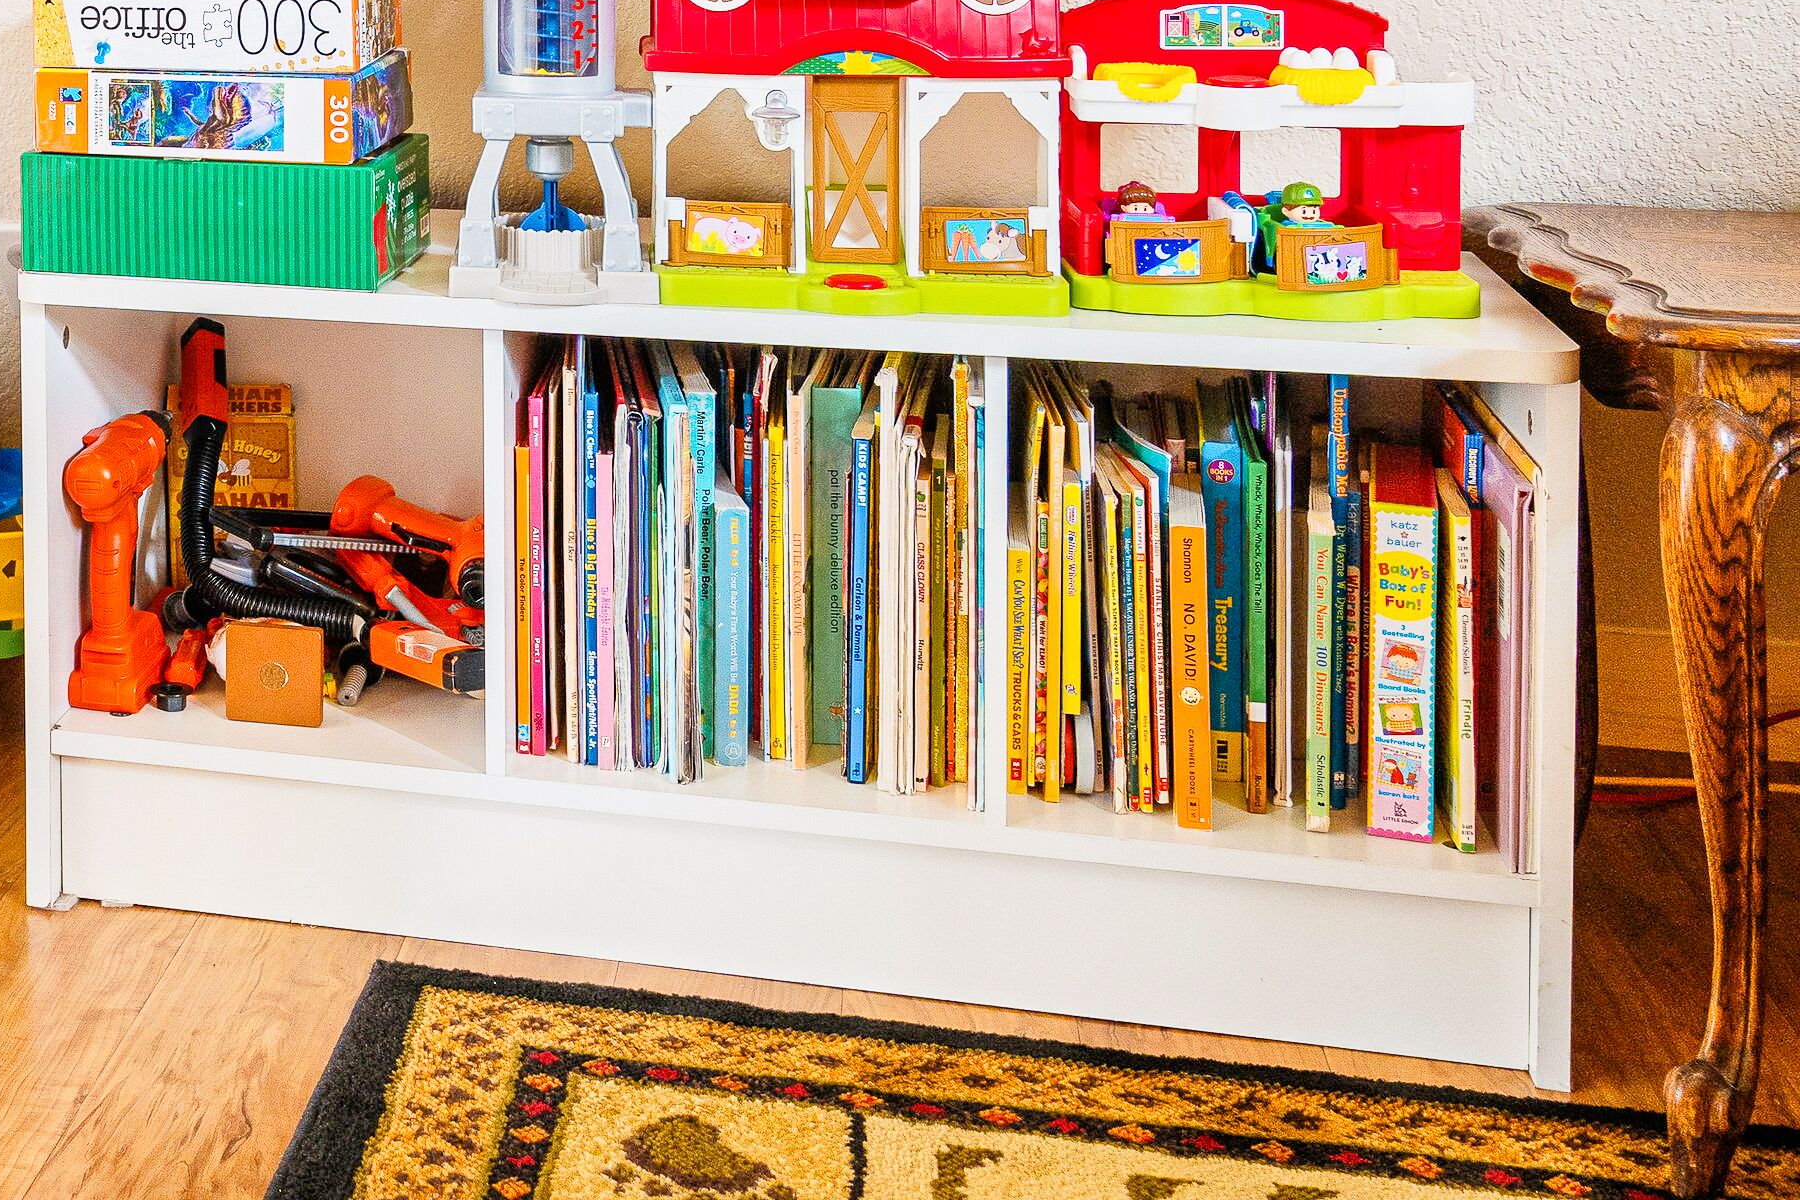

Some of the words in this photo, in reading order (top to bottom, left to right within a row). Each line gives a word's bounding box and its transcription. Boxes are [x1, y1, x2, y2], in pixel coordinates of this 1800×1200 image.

[80, 5, 187, 39] office
[571, 20, 584, 40] 2
[161, 31, 196, 50] the
[573, 49, 581, 70] 1
[329, 94, 349, 144] 300
[228, 388, 282, 401] HAM
[229, 401, 282, 413] KERS
[586, 409, 595, 435] Blue's
[696, 411, 706, 442] Martin
[1333, 388, 1348, 471] Unstoppable
[233, 439, 281, 464] Honey
[696, 449, 706, 475] Carle
[771, 451, 781, 475] Toes
[857, 443, 867, 469] KIDS
[828, 469, 840, 487] pat
[1210, 468, 1233, 476] BOOKS
[1219, 461, 1224, 469] 8
[771, 478, 781, 496] Are
[857, 471, 867, 507] CAMP!
[1254, 474, 1263, 501] Whack,
[1336, 474, 1348, 498] Me!
[701, 488, 711, 516] Polar
[771, 499, 780, 510] to
[830, 492, 841, 509] the
[771, 512, 781, 544] Tickle
[1254, 503, 1263, 530] Whack,
[1391, 520, 1418, 531] katz
[531, 527, 540, 542] All
[586, 518, 597, 551] Blue's
[699, 518, 711, 544] Bear,
[827, 513, 841, 548] bunny
[1336, 525, 1346, 540] Dr.
[1387, 537, 1422, 548] bauer
[531, 544, 540, 561] for
[793, 533, 802, 566] LITTLE
[916, 542, 925, 570] CLASS
[1066, 530, 1076, 561] Rolling
[1254, 532, 1263, 559] Whack,
[584, 554, 597, 570] Big
[701, 546, 711, 573] Polar
[830, 552, 842, 590] deluxe
[1124, 555, 1133, 568] Tree
[1183, 538, 1193, 584] Shannon
[1254, 561, 1262, 581] Goes
[1317, 548, 1329, 571] You
[1335, 544, 1346, 577] Wayne
[1378, 562, 1430, 579] Baby's
[699, 576, 711, 601] Bear,
[730, 571, 738, 589] Your
[916, 571, 925, 603] CLOWN
[1254, 582, 1262, 597] The
[1317, 575, 1329, 599] Can
[1336, 581, 1346, 593] W.
[1380, 578, 1407, 592] Box
[1411, 582, 1426, 594] of
[585, 573, 597, 619] Birthday
[729, 590, 739, 615] Baby's
[793, 570, 802, 637] LOCOMOTIVE
[855, 577, 863, 612] Carlson
[1347, 575, 1359, 617] Where
[1385, 595, 1421, 611] Fun!
[730, 615, 738, 633] First
[830, 594, 841, 633] edition
[1126, 602, 1134, 634] VACATION
[1316, 604, 1328, 640] Name
[730, 634, 738, 657] Word
[853, 624, 863, 662] Dammel
[1126, 635, 1135, 657] UNDER
[1211, 596, 1233, 671] Treasury
[587, 650, 596, 677] Simon
[730, 657, 738, 672] Will
[917, 639, 925, 671] Hurwitz
[1184, 634, 1196, 681] DAVID!
[1316, 646, 1328, 667] 100
[1346, 636, 1360, 677] Baby's
[728, 684, 740, 715] DADA
[1011, 671, 1022, 712] TRUCKS
[1127, 672, 1135, 703] VOLCANO
[1403, 686, 1426, 695] Books
[1128, 708, 1137, 723] Mary
[1315, 672, 1328, 737] Dinosaurs!
[1346, 681, 1358, 735] Mommy?
[1158, 690, 1167, 746] ADVENTURE
[1461, 699, 1472, 739] Frindle
[587, 738, 596, 750] Jr.
[1012, 723, 1022, 750] CARS
[1416, 741, 1426, 749] by
[1316, 755, 1327, 798] Scholastic
